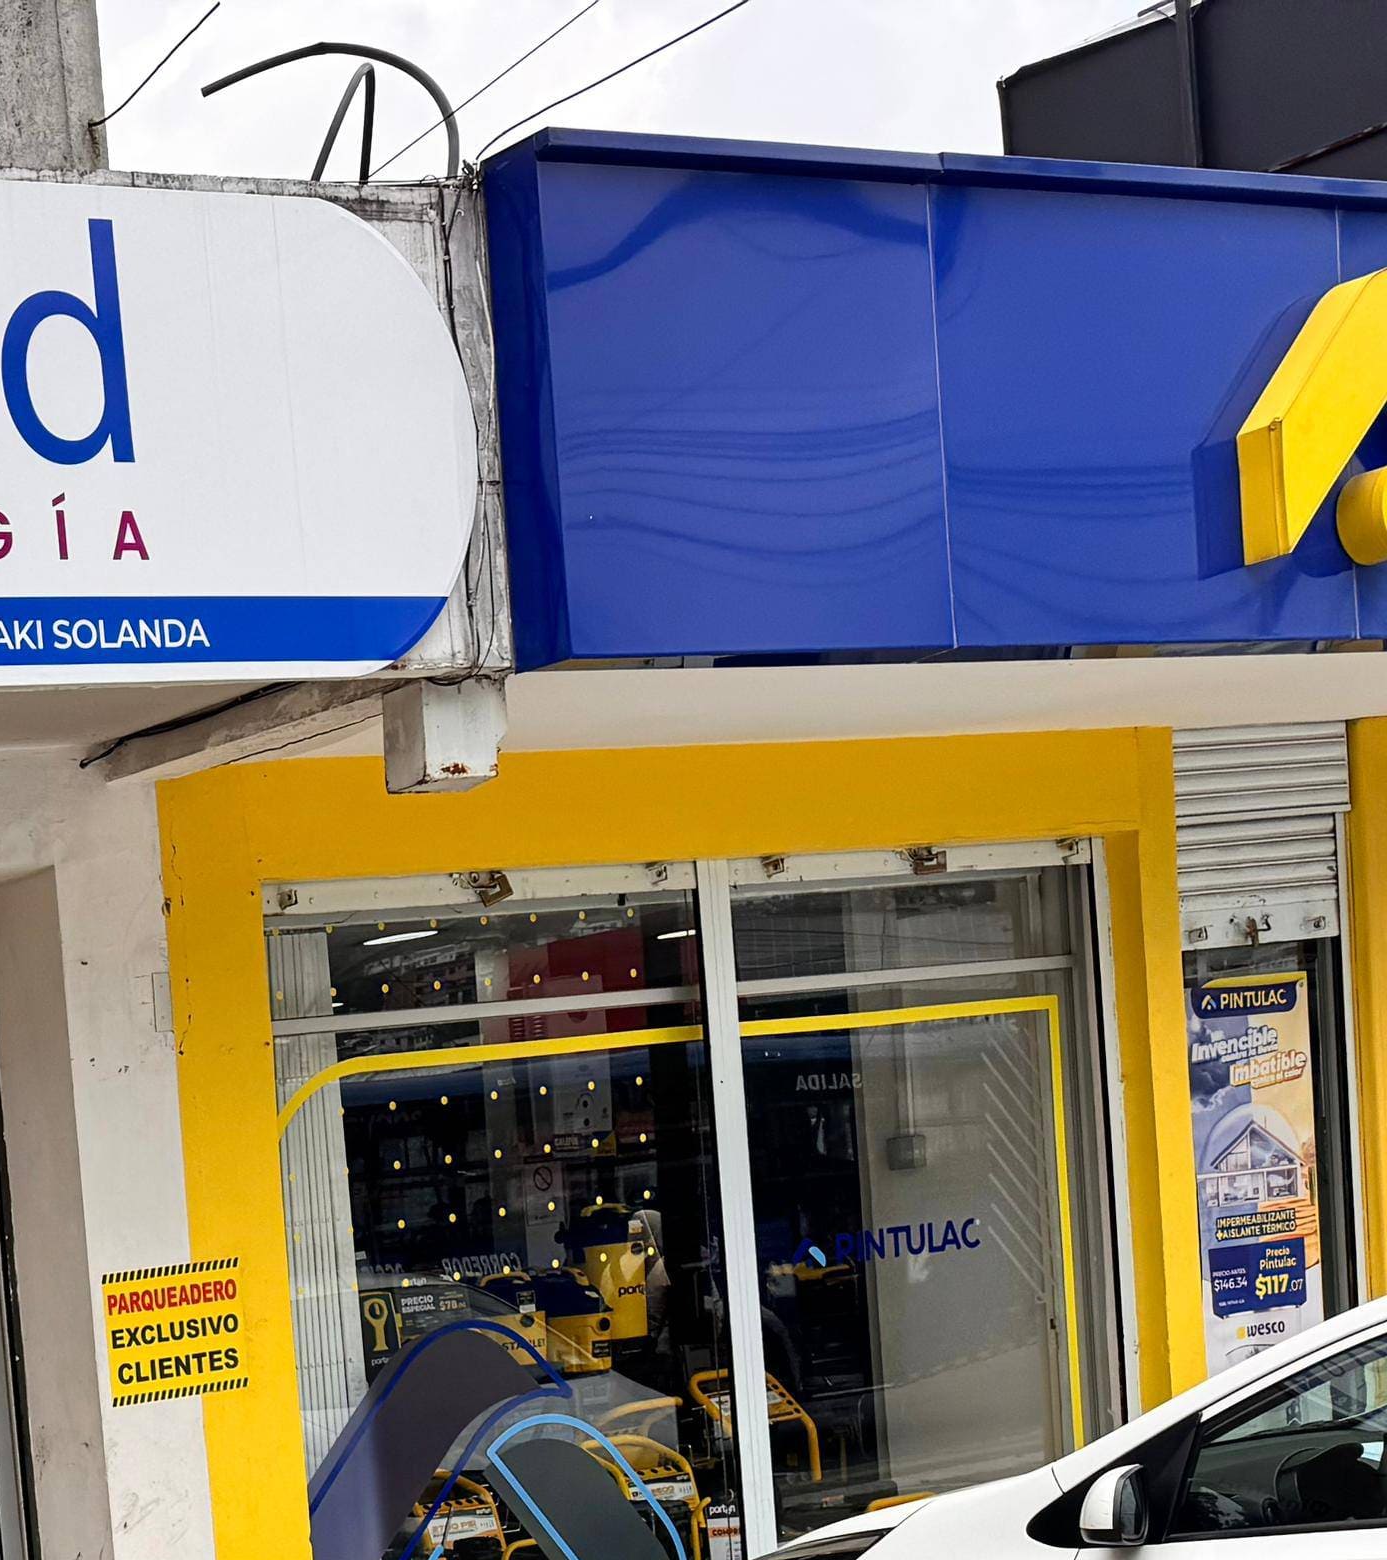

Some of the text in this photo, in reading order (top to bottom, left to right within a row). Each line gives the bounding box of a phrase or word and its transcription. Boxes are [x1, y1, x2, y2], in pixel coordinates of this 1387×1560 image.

[52, 617, 211, 650] SOLANDA
[1219, 987, 1288, 1011] PINTULAC
[1191, 1025, 1278, 1063] Invencible
[1230, 1048, 1308, 1087] Imbatible
[835, 1218, 981, 1265] PINTULAC
[1259, 1256, 1297, 1271] Pintulac
[106, 1278, 238, 1317] PARQUEADERO
[111, 1313, 239, 1350] EXCLUSIVO
[1246, 1320, 1286, 1338] wesco
[117, 1347, 240, 1386] CLIENTES
